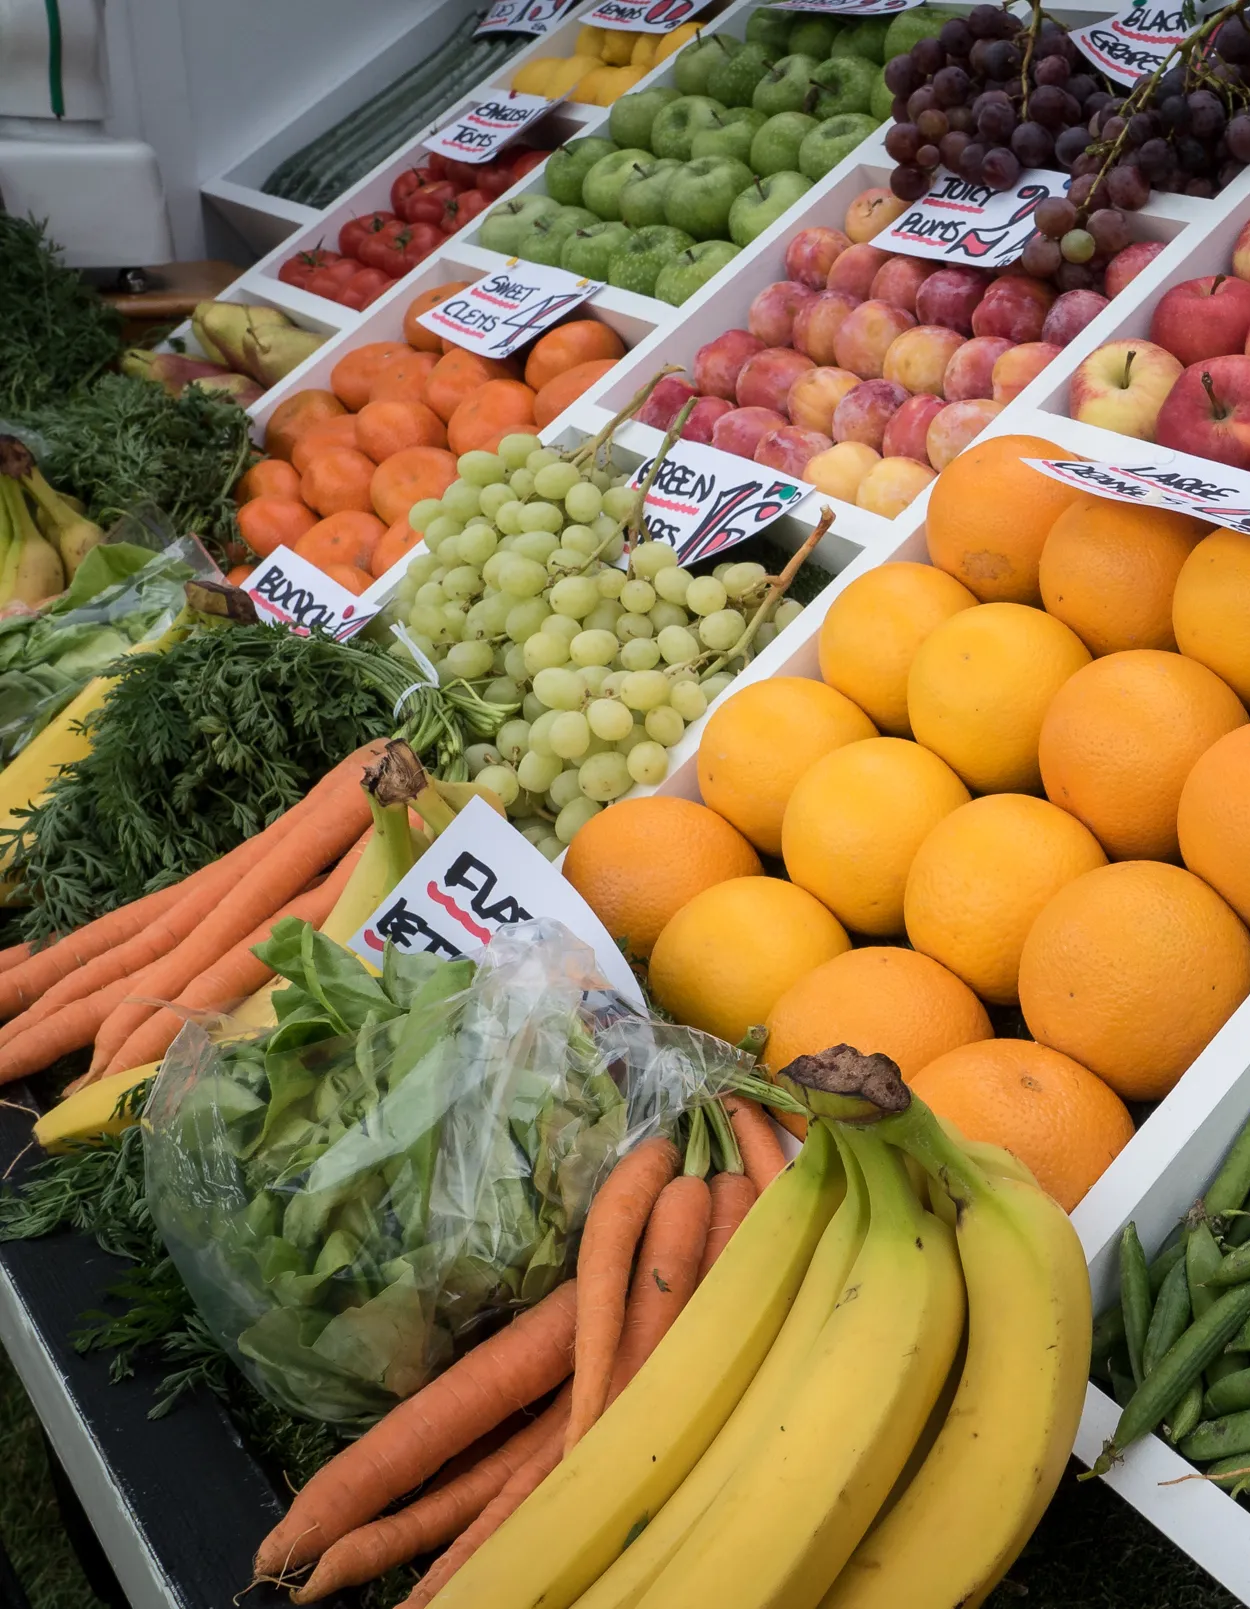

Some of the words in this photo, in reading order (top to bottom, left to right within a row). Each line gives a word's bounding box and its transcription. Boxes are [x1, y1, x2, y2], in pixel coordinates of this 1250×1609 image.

[928, 177, 1003, 207] JUICY
[896, 212, 967, 242] PLUMS
[482, 275, 541, 304] SWEET
[637, 457, 716, 504] GREEN
[1121, 465, 1241, 502] LARGE
